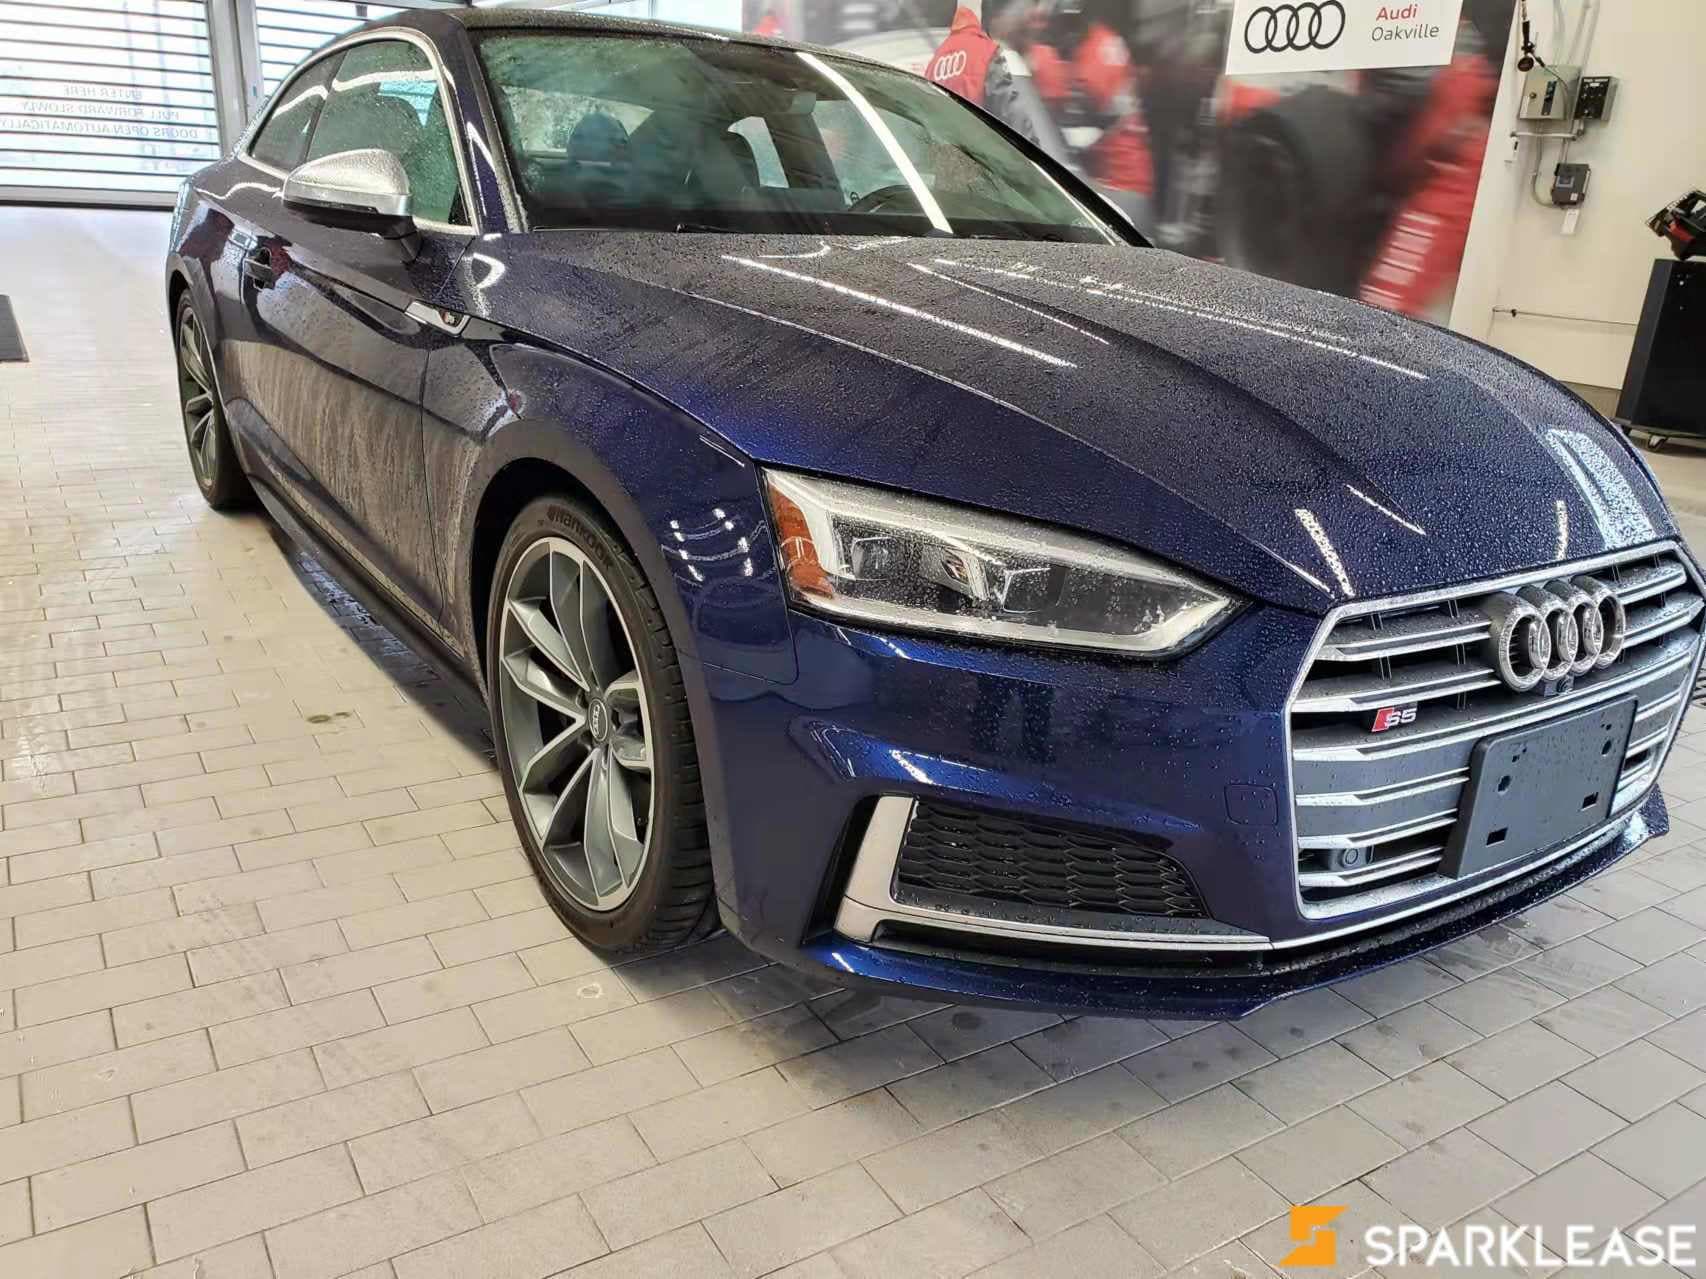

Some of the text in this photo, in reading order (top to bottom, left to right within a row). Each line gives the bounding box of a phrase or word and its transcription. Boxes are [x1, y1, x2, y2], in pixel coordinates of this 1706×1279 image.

[1376, 4, 1418, 21] Audi
[1372, 24, 1440, 42] Oakville
[1384, 707, 1417, 727] S5
